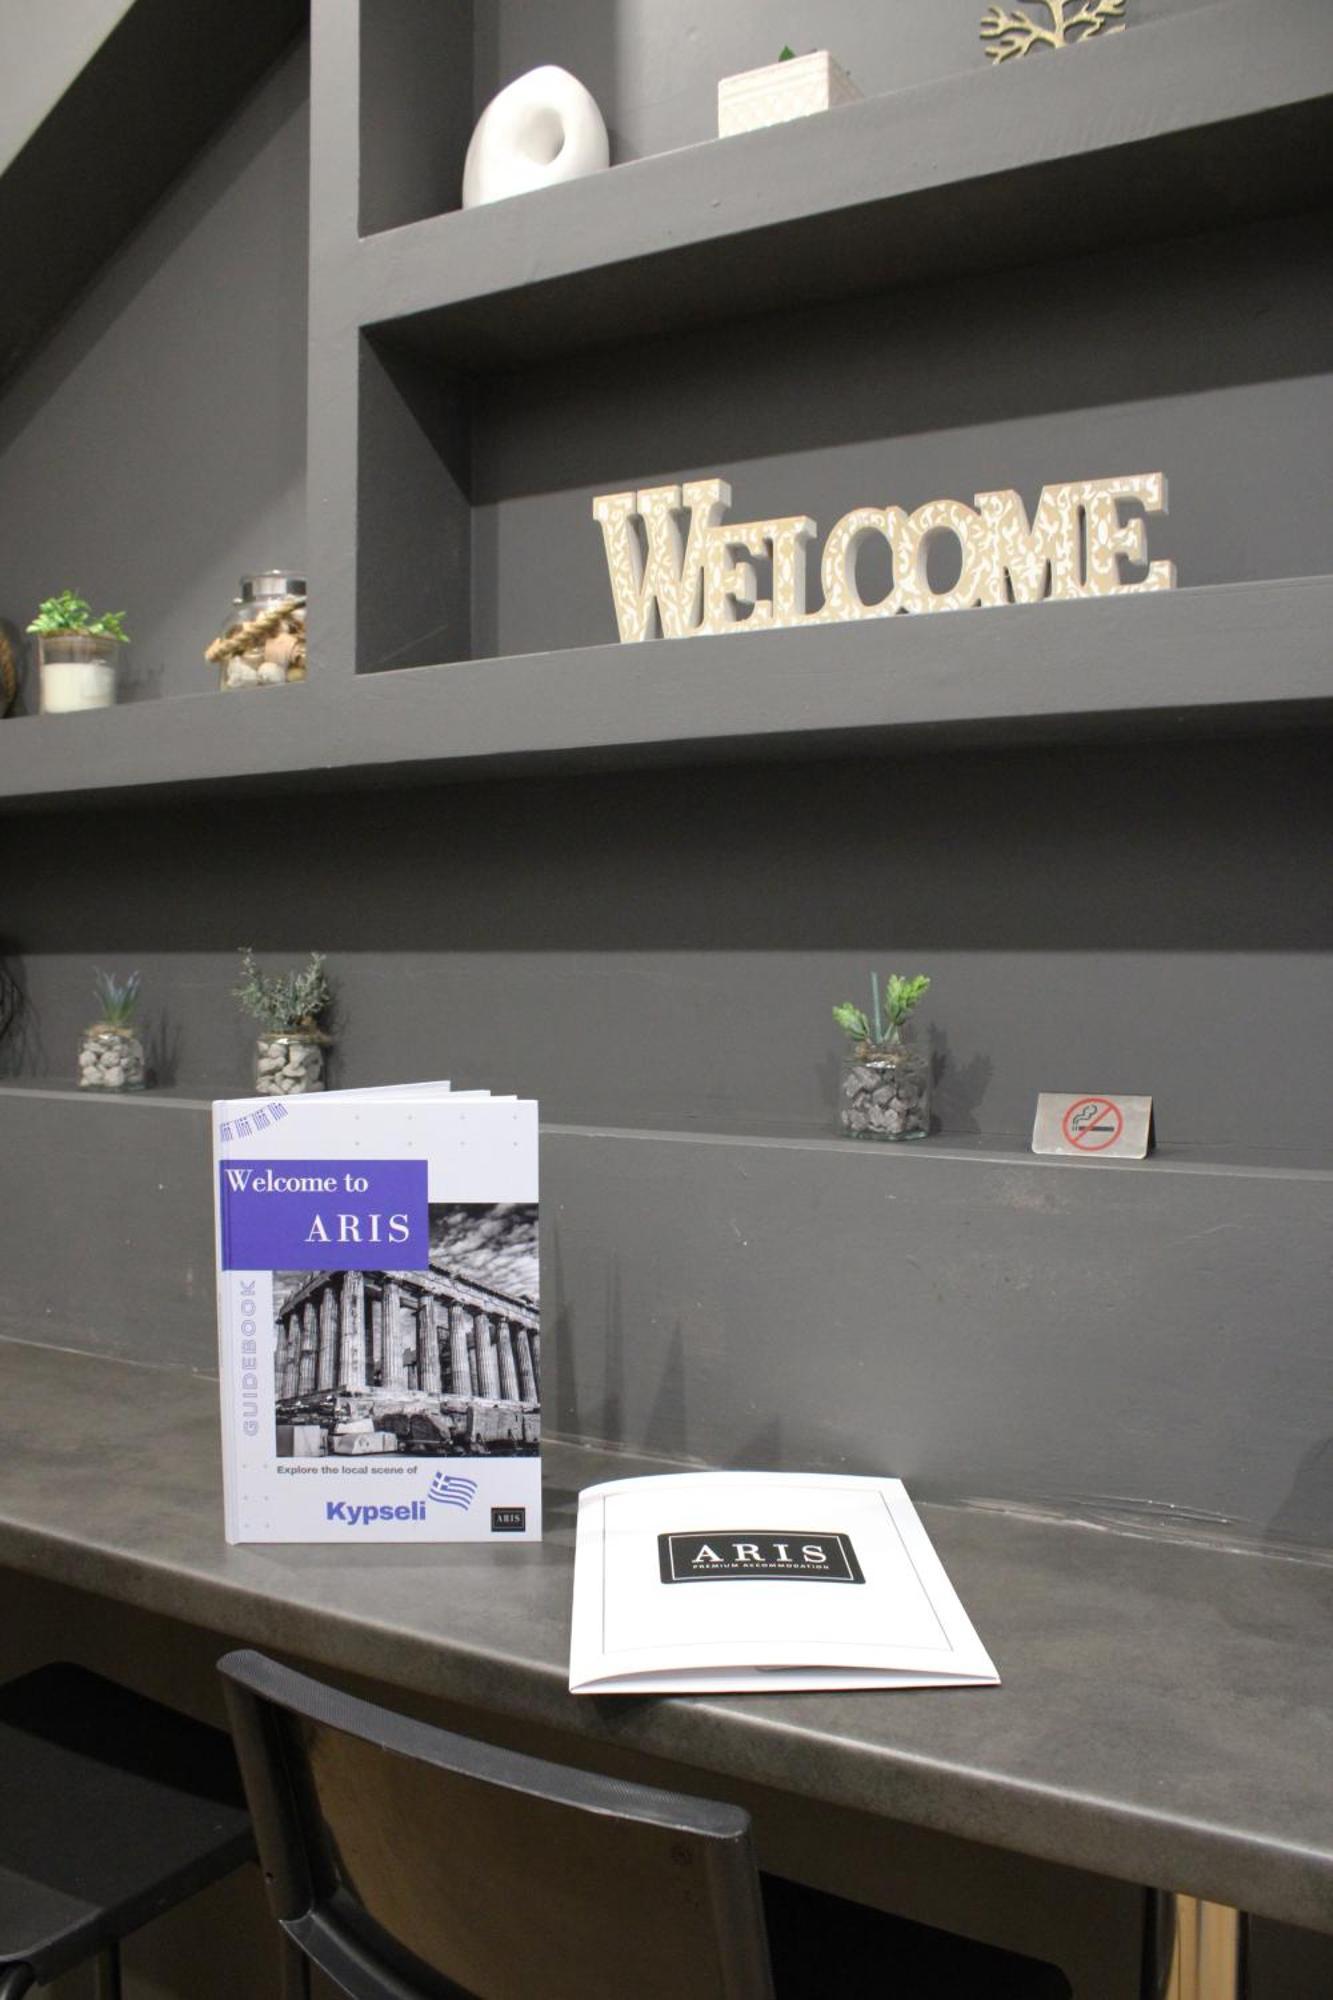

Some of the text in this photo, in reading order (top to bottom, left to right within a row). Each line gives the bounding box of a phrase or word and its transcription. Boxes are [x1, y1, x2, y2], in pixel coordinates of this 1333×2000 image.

[593, 472, 1177, 643] WELCOME
[224, 1168, 369, 1193] Welcome to
[304, 1214, 410, 1243] ARIS
[240, 1279, 259, 1437] GUIDEBOOK
[277, 1465, 418, 1475] Explore the local scene of
[326, 1501, 426, 1525] Kypseli
[496, 1513, 521, 1523] ARIS
[691, 1543, 828, 1564] ARIS
[692, 1562, 739, 1570] PREMIUM
